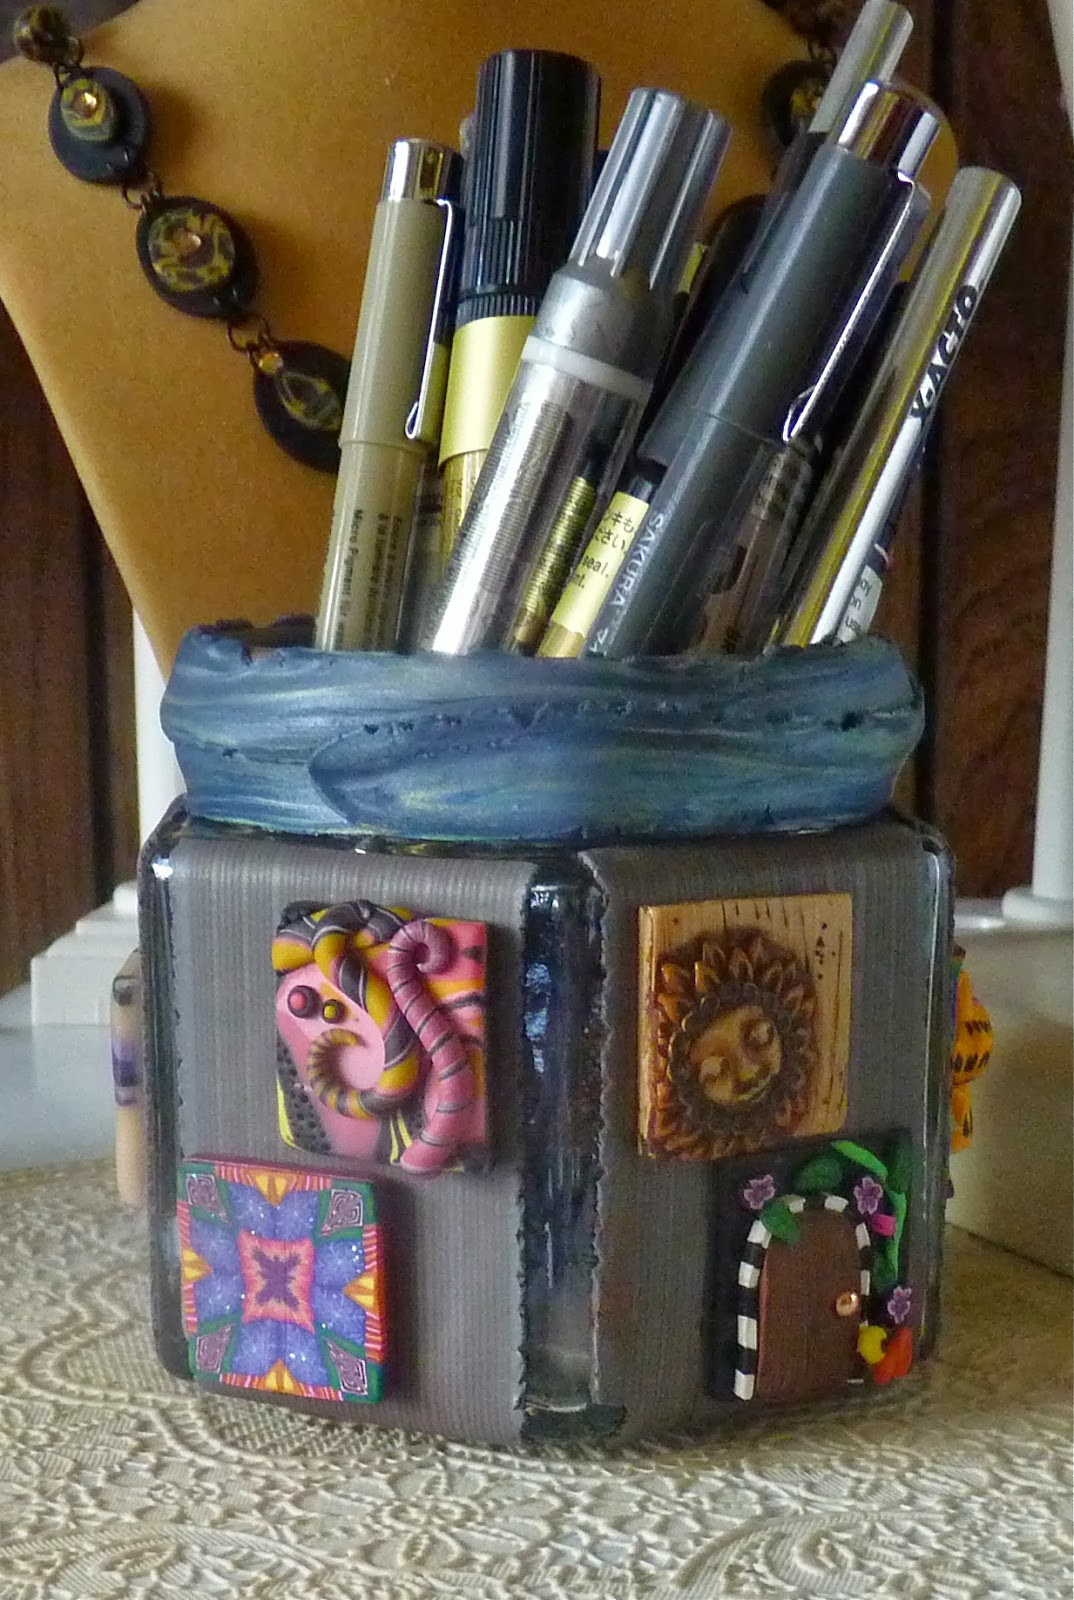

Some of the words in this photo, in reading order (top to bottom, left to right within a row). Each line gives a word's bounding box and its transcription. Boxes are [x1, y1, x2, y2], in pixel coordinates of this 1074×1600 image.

[910, 285, 978, 421] X-ACTO
[348, 509, 363, 544] Micro
[610, 509, 664, 606] SAKURA
